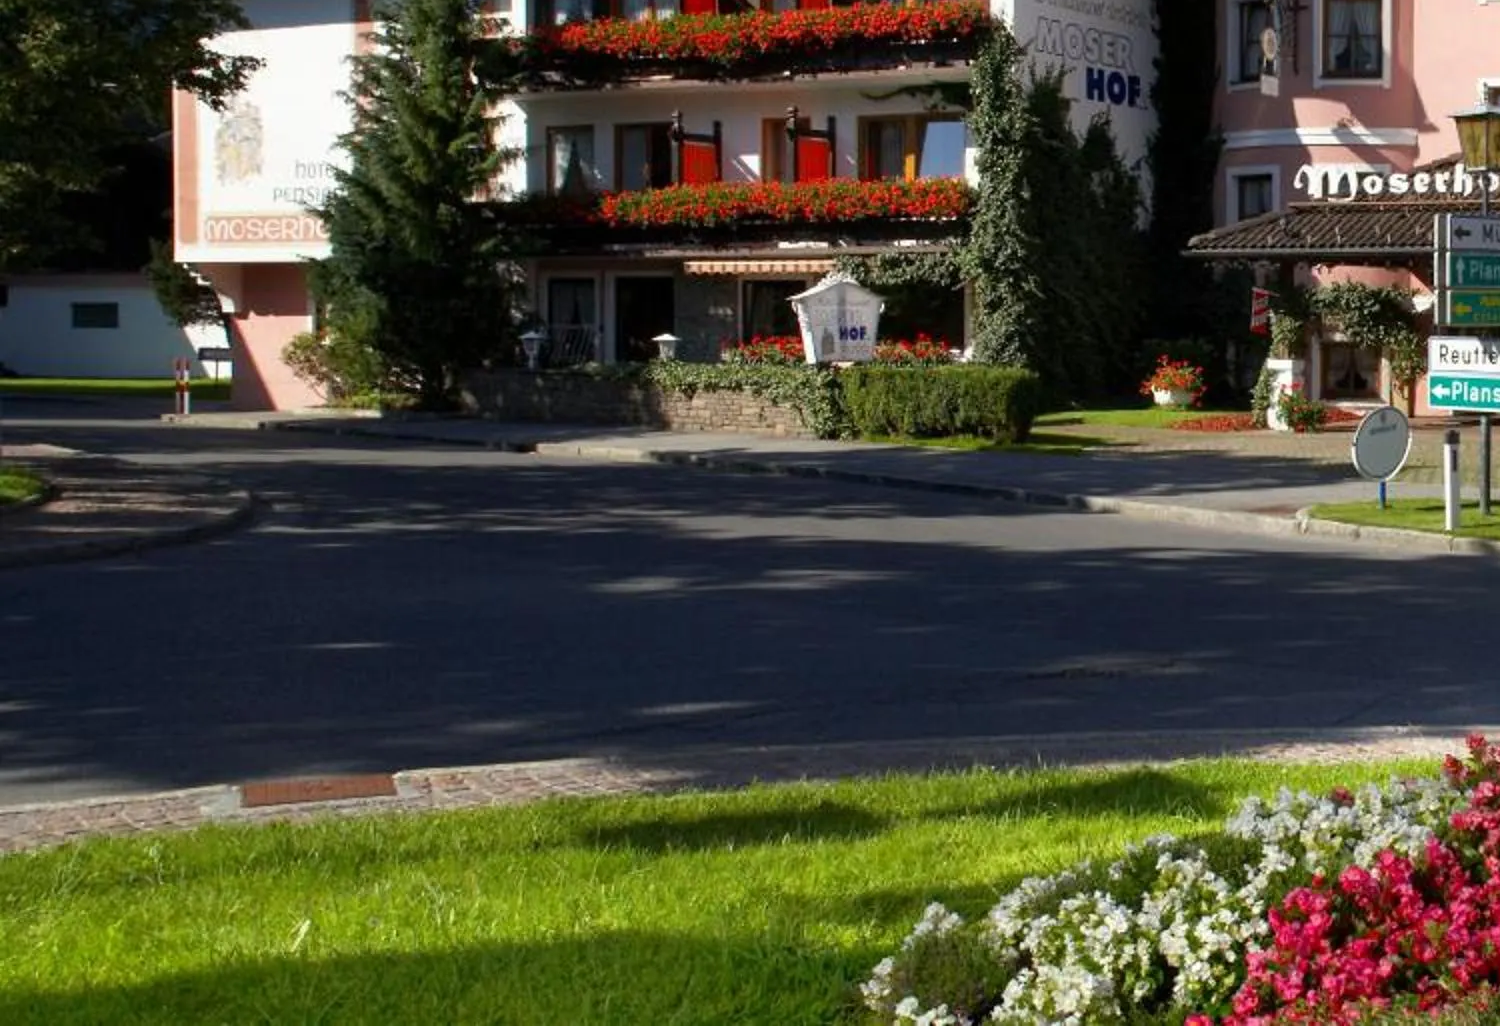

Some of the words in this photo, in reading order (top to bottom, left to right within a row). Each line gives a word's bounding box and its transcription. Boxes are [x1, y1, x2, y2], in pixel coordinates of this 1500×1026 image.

[1036, 15, 1137, 75] MOSER
[1086, 66, 1141, 108] HOF
[295, 158, 340, 178] HOTE
[206, 216, 331, 240] MOSERHO
[1439, 343, 1499, 365] Reutte
